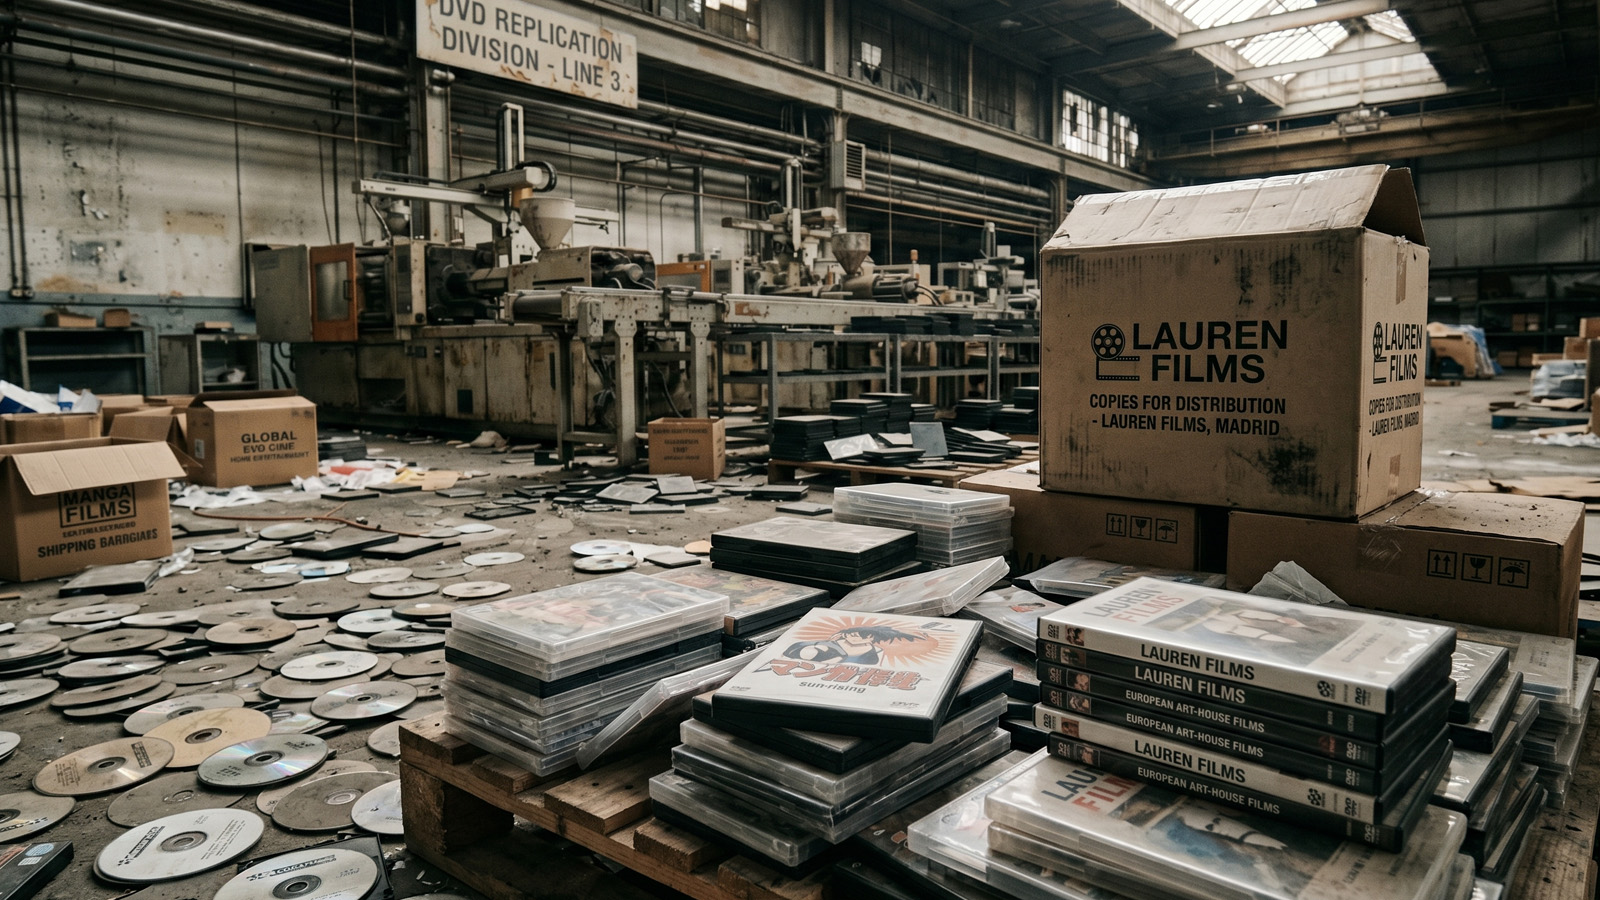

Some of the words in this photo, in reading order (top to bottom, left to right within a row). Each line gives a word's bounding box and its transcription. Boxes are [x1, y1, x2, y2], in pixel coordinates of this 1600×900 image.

[440, 0, 486, 25] DVD
[495, 8, 622, 64] REPLICATION
[443, 26, 539, 72] DIVISION
[562, 57, 604, 88] LINE
[1133, 320, 1288, 350] LAUREN
[1385, 322, 1423, 350] LAUREN
[1152, 354, 1265, 383] FILMS
[1390, 353, 1418, 382] FILMS
[1090, 394, 1138, 409] COPIES
[1142, 395, 1171, 410] FOR
[1176, 396, 1286, 414] DISTRIBUTION
[241, 431, 298, 443] GLOBAL
[1102, 414, 1156, 430] LAUREN
[1161, 416, 1211, 435] FILMS,
[1216, 418, 1280, 435] MADRID
[64, 485, 131, 506] MANGA
[66, 499, 131, 522] FILMS
[38, 539, 96, 558] SHIPPING
[1111, 595, 1184, 622] FILMS
[1141, 644, 1200, 669] LAUREN
[1205, 657, 1255, 680] FILMS
[1135, 666, 1193, 692] LAUREN
[1197, 680, 1246, 704] FILMS
[1126, 690, 1174, 710] EUROPEAN
[1176, 703, 1231, 724] ART-HOUSE
[1233, 716, 1265, 733] FILMS
[1126, 713, 1174, 734] EUROPEAN
[1176, 727, 1231, 749] ART-HOUSE
[1232, 741, 1264, 758] FILMS
[1135, 740, 1192, 768] LAUREN
[1198, 757, 1246, 783] FILMS
[1138, 767, 1187, 788] EUROPEAN
[1189, 782, 1245, 804] ART-HOUSE
[1248, 797, 1281, 815] FILMS
